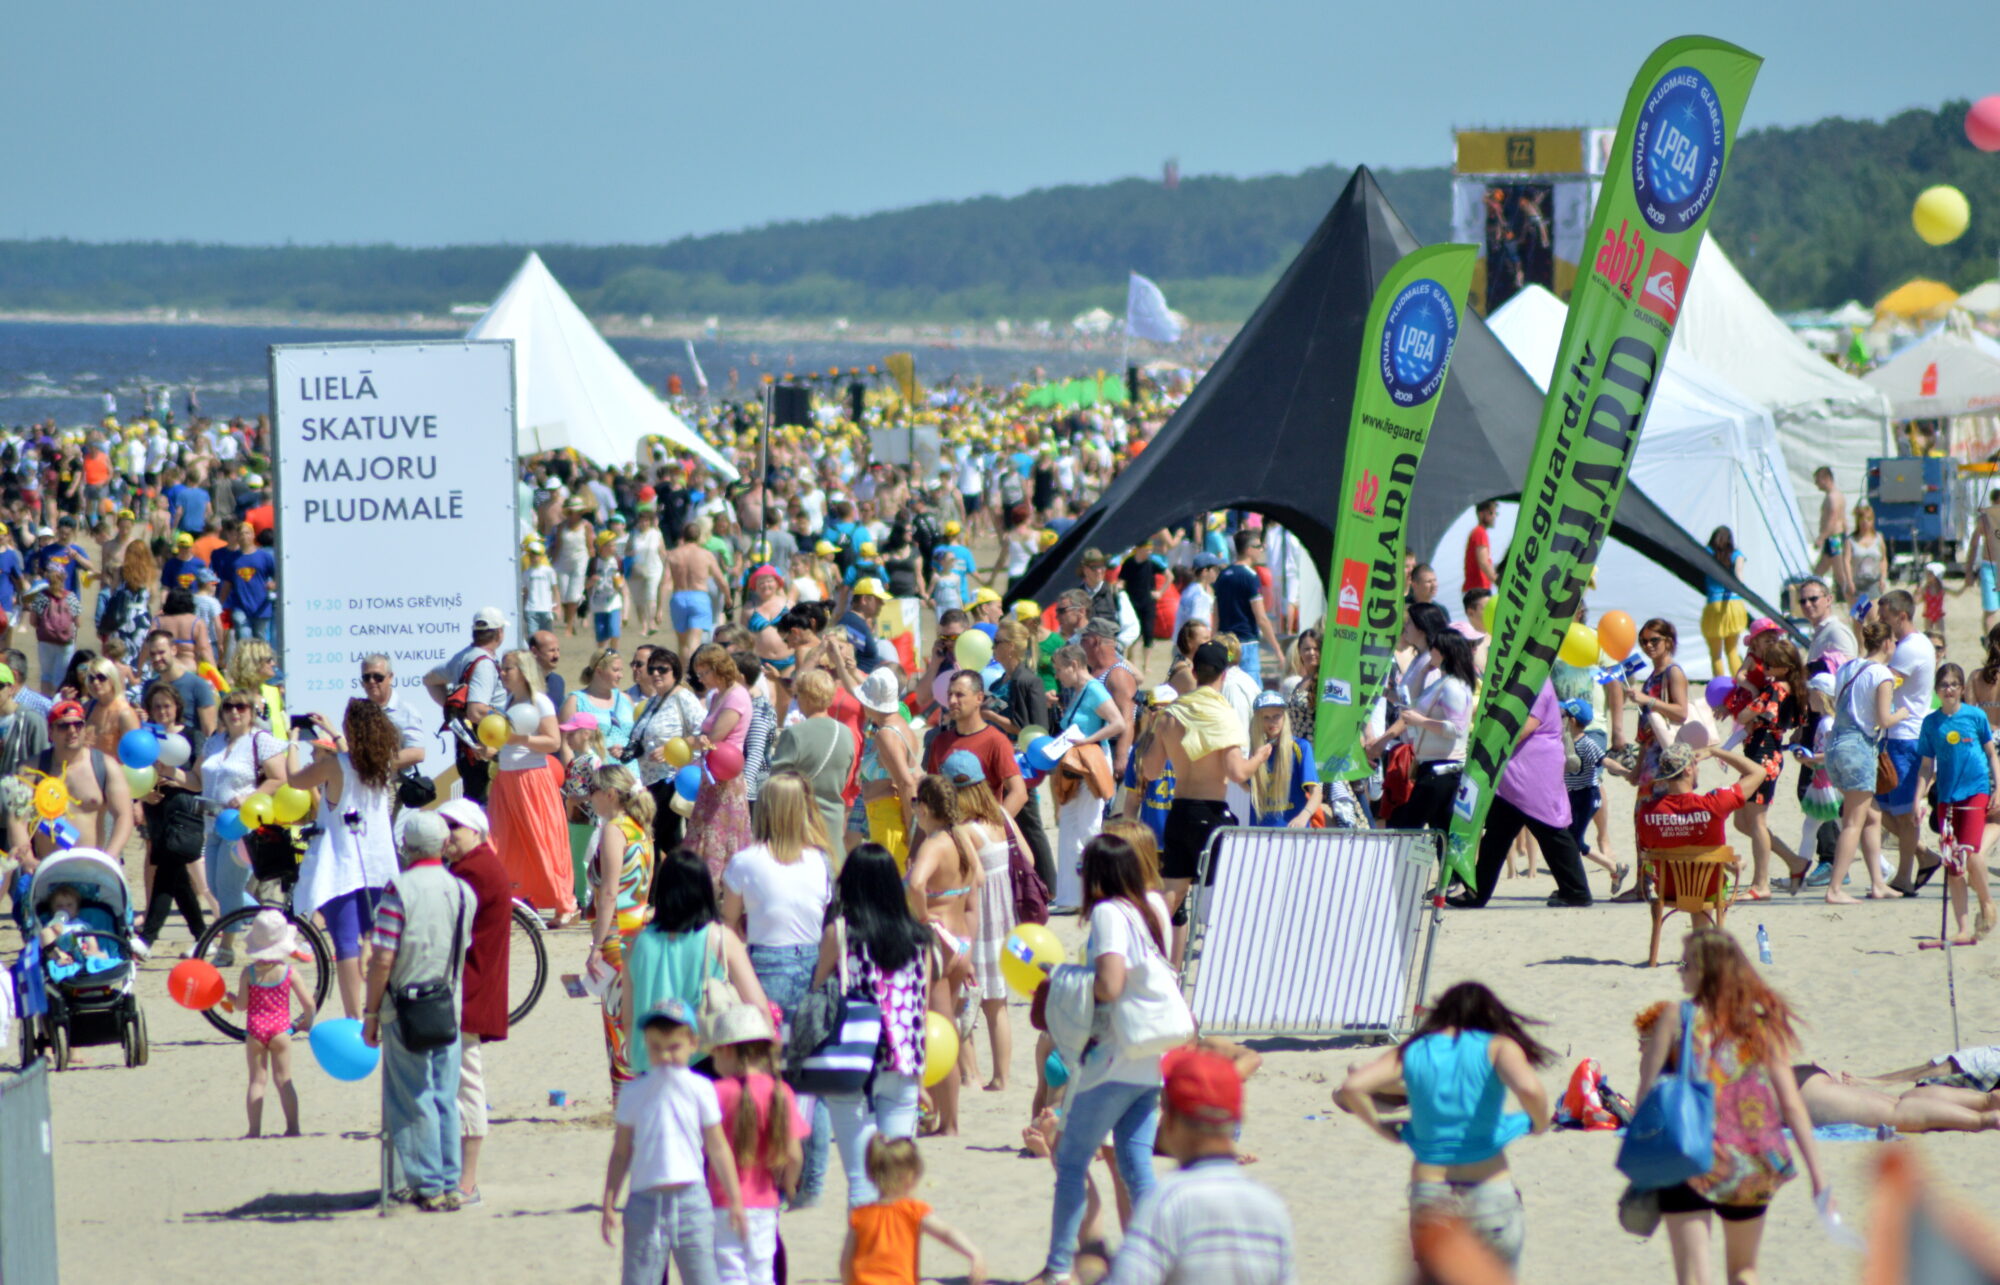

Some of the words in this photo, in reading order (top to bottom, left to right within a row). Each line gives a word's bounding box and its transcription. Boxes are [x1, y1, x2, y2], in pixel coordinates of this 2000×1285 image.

[1636, 120, 1649, 190] LATVIJAS
[1648, 75, 1699, 113] PLUDMALES
[1653, 119, 1700, 181] LPGA
[1389, 284, 1430, 324] PLUDMALES
[1398, 323, 1436, 362] LPGA
[300, 370, 378, 401] LIELĀ
[301, 415, 438, 442] SKATUVE
[303, 455, 437, 482] MAJORU
[304, 490, 463, 523] PLUDMALĒ
[306, 599, 342, 611] 19.30
[349, 599, 363, 610] DJ
[367, 597, 404, 609] TOMS
[407, 592, 463, 611] GRĒVIŅŠ
[305, 625, 342, 637] 20.00
[349, 623, 413, 636] CARNIVAL
[417, 622, 460, 634] YOUTH
[306, 652, 343, 664] 22.00
[350, 650, 390, 663] LAA
[394, 648, 446, 661] VAIKULE
[307, 679, 344, 690] 22.50
[1644, 810, 1711, 826] LIFEGUARD
